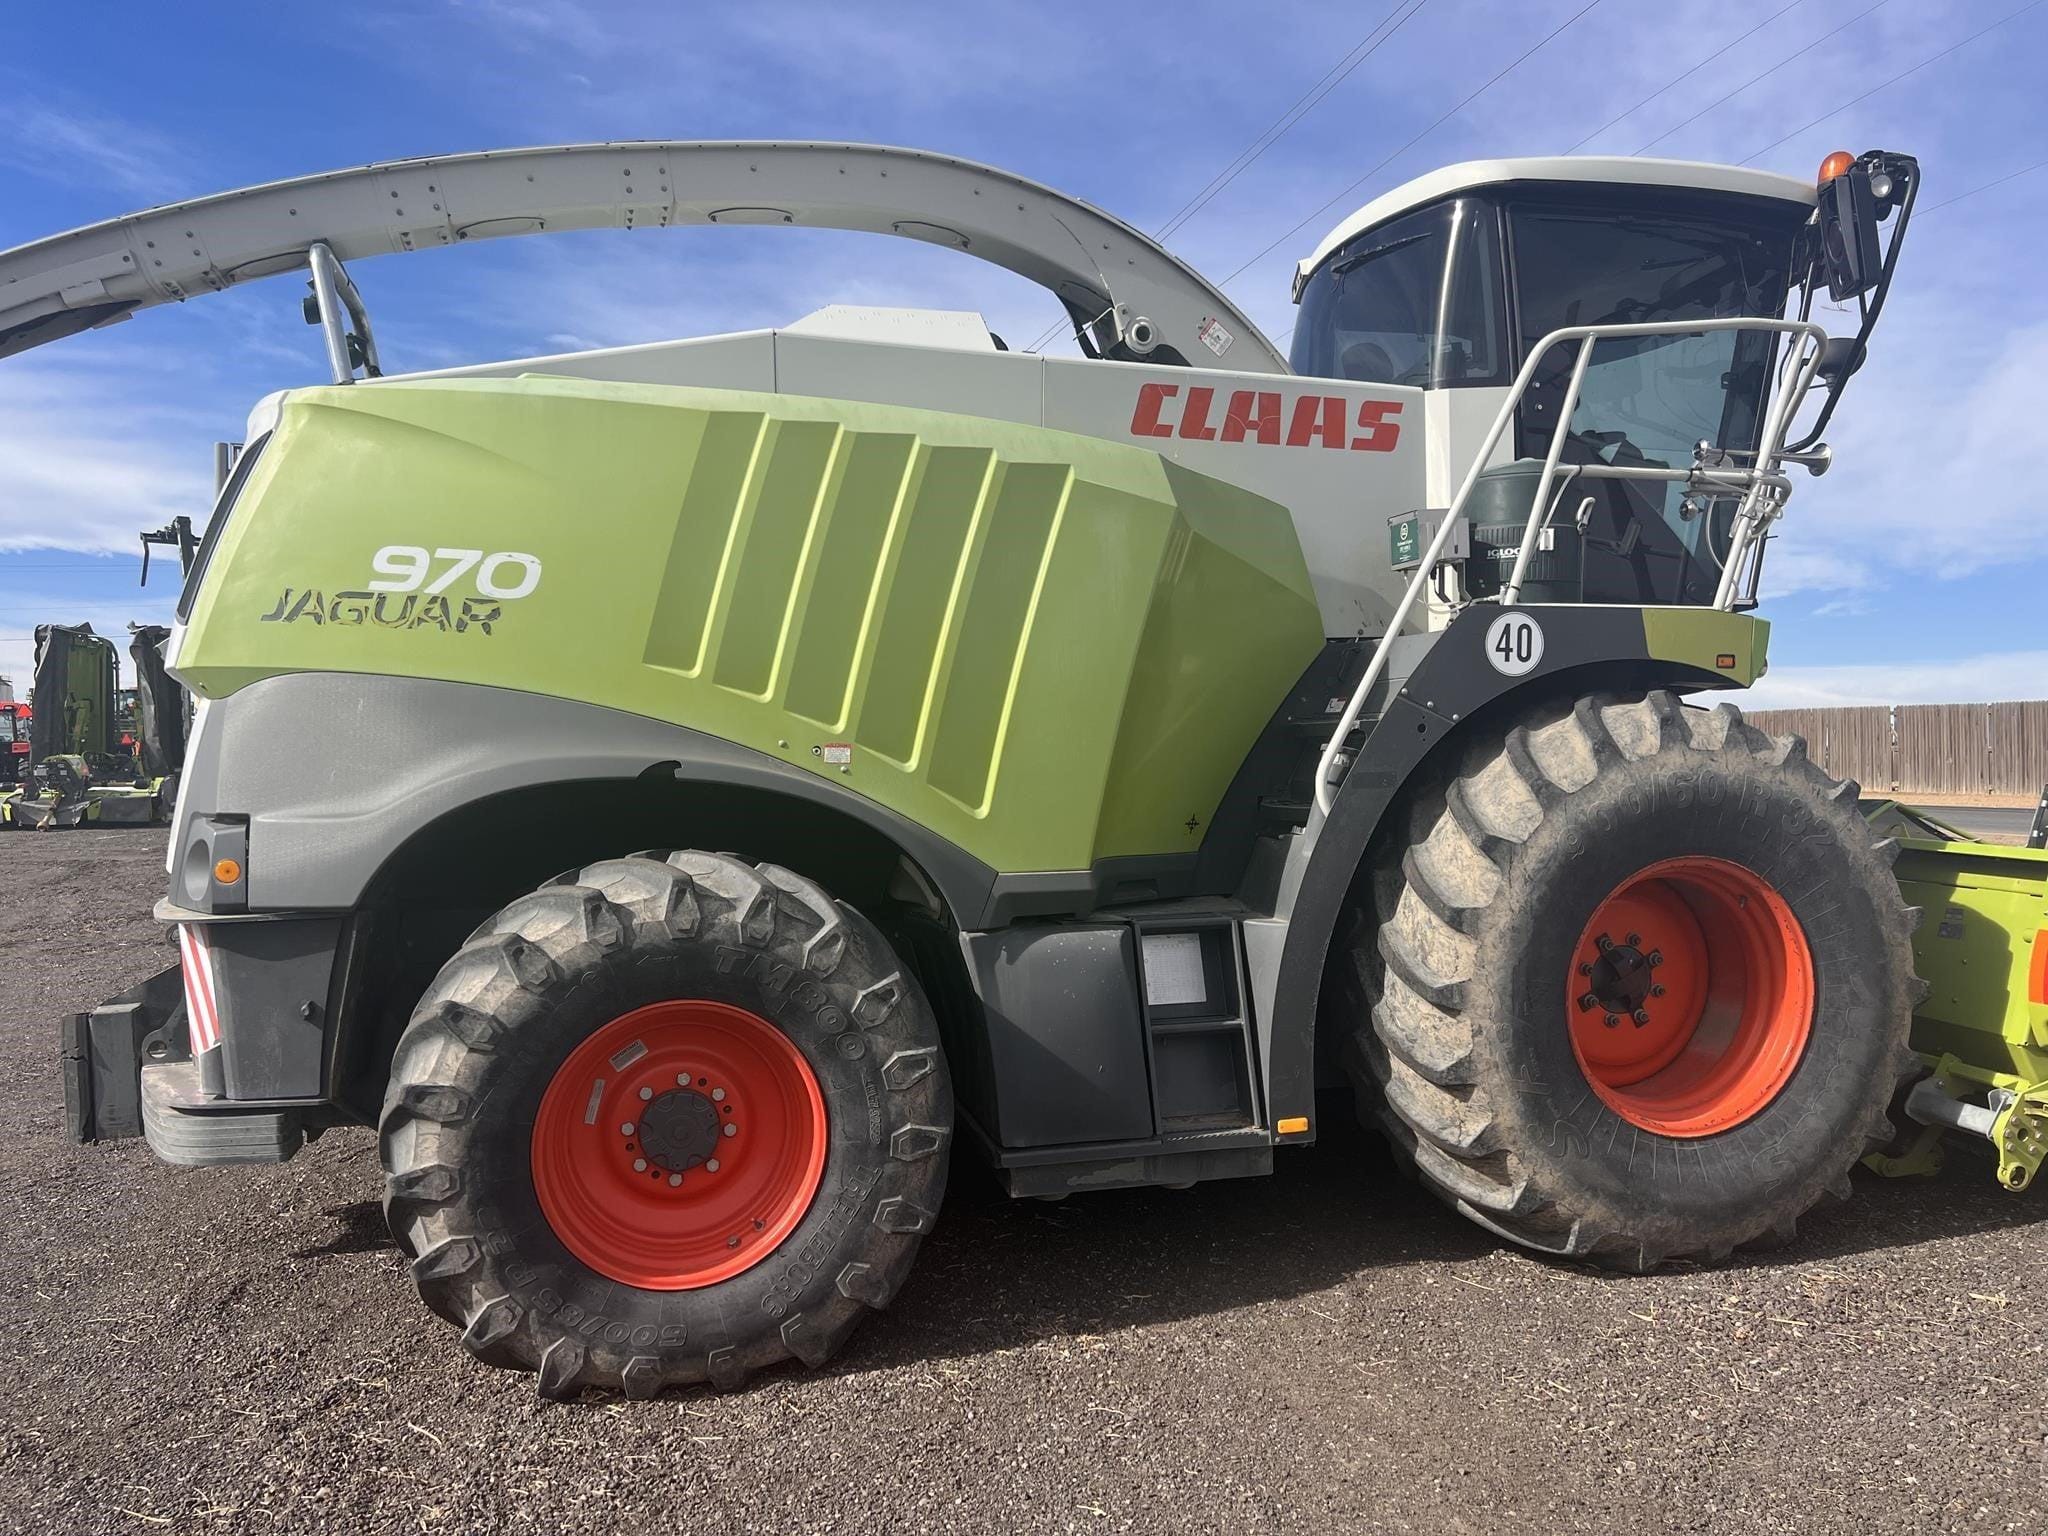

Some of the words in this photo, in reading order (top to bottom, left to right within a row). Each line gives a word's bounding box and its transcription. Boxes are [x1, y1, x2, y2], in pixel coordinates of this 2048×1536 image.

[1130, 382, 1404, 453] CLAAS
[367, 545, 542, 600] 970
[260, 587, 502, 636] JAGUAR
[1495, 622, 1533, 663] 40
